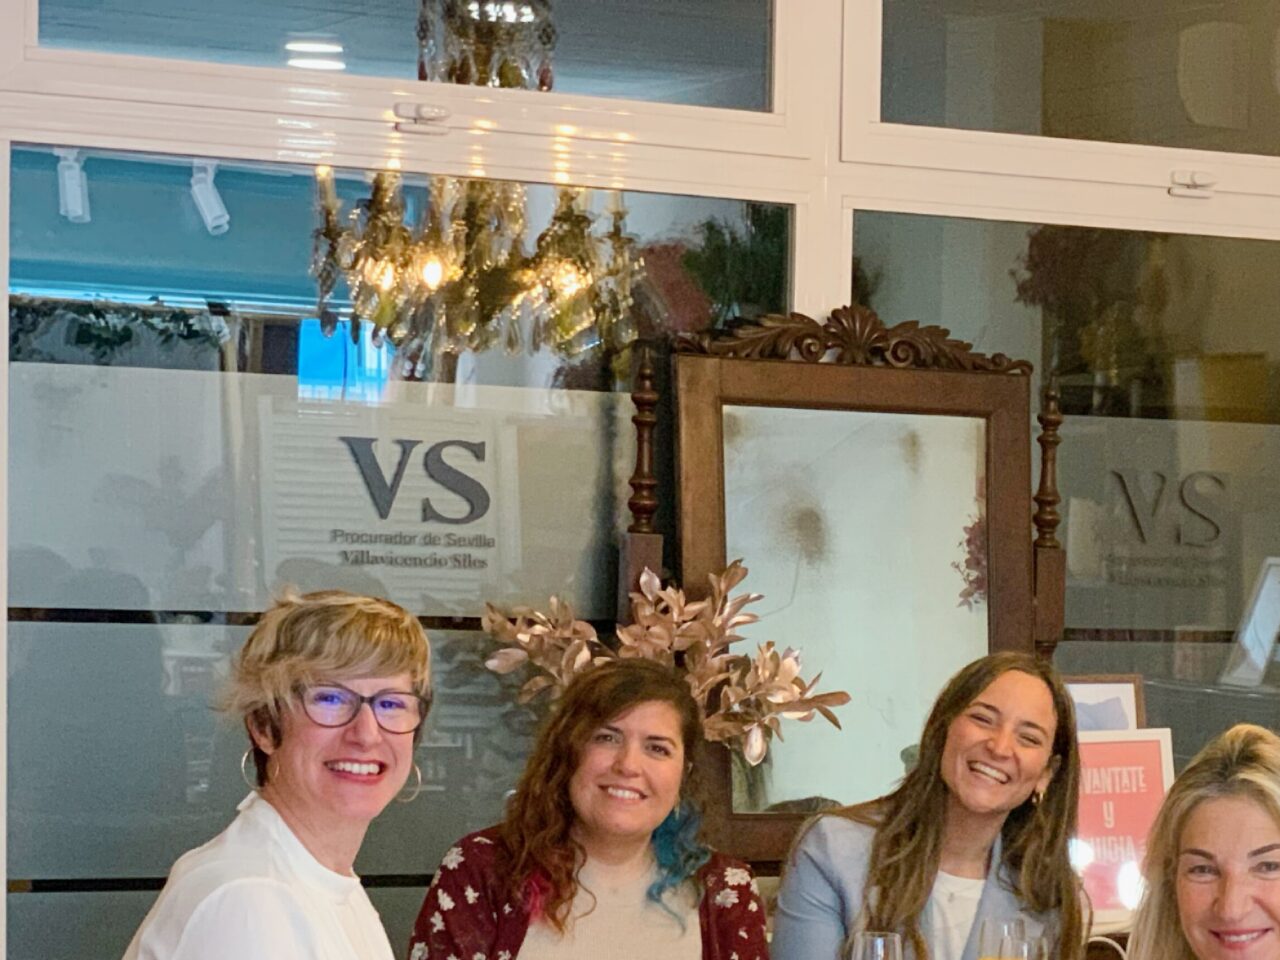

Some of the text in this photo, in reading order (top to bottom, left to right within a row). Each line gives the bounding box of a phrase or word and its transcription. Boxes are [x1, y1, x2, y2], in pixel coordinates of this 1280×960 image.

[338, 436, 490, 525] VS
[1111, 470, 1226, 548] VS
[332, 529, 495, 548] Procurador de Sevilla
[341, 550, 448, 568] Villavicencio
[1079, 766, 1148, 794] VANTATE
